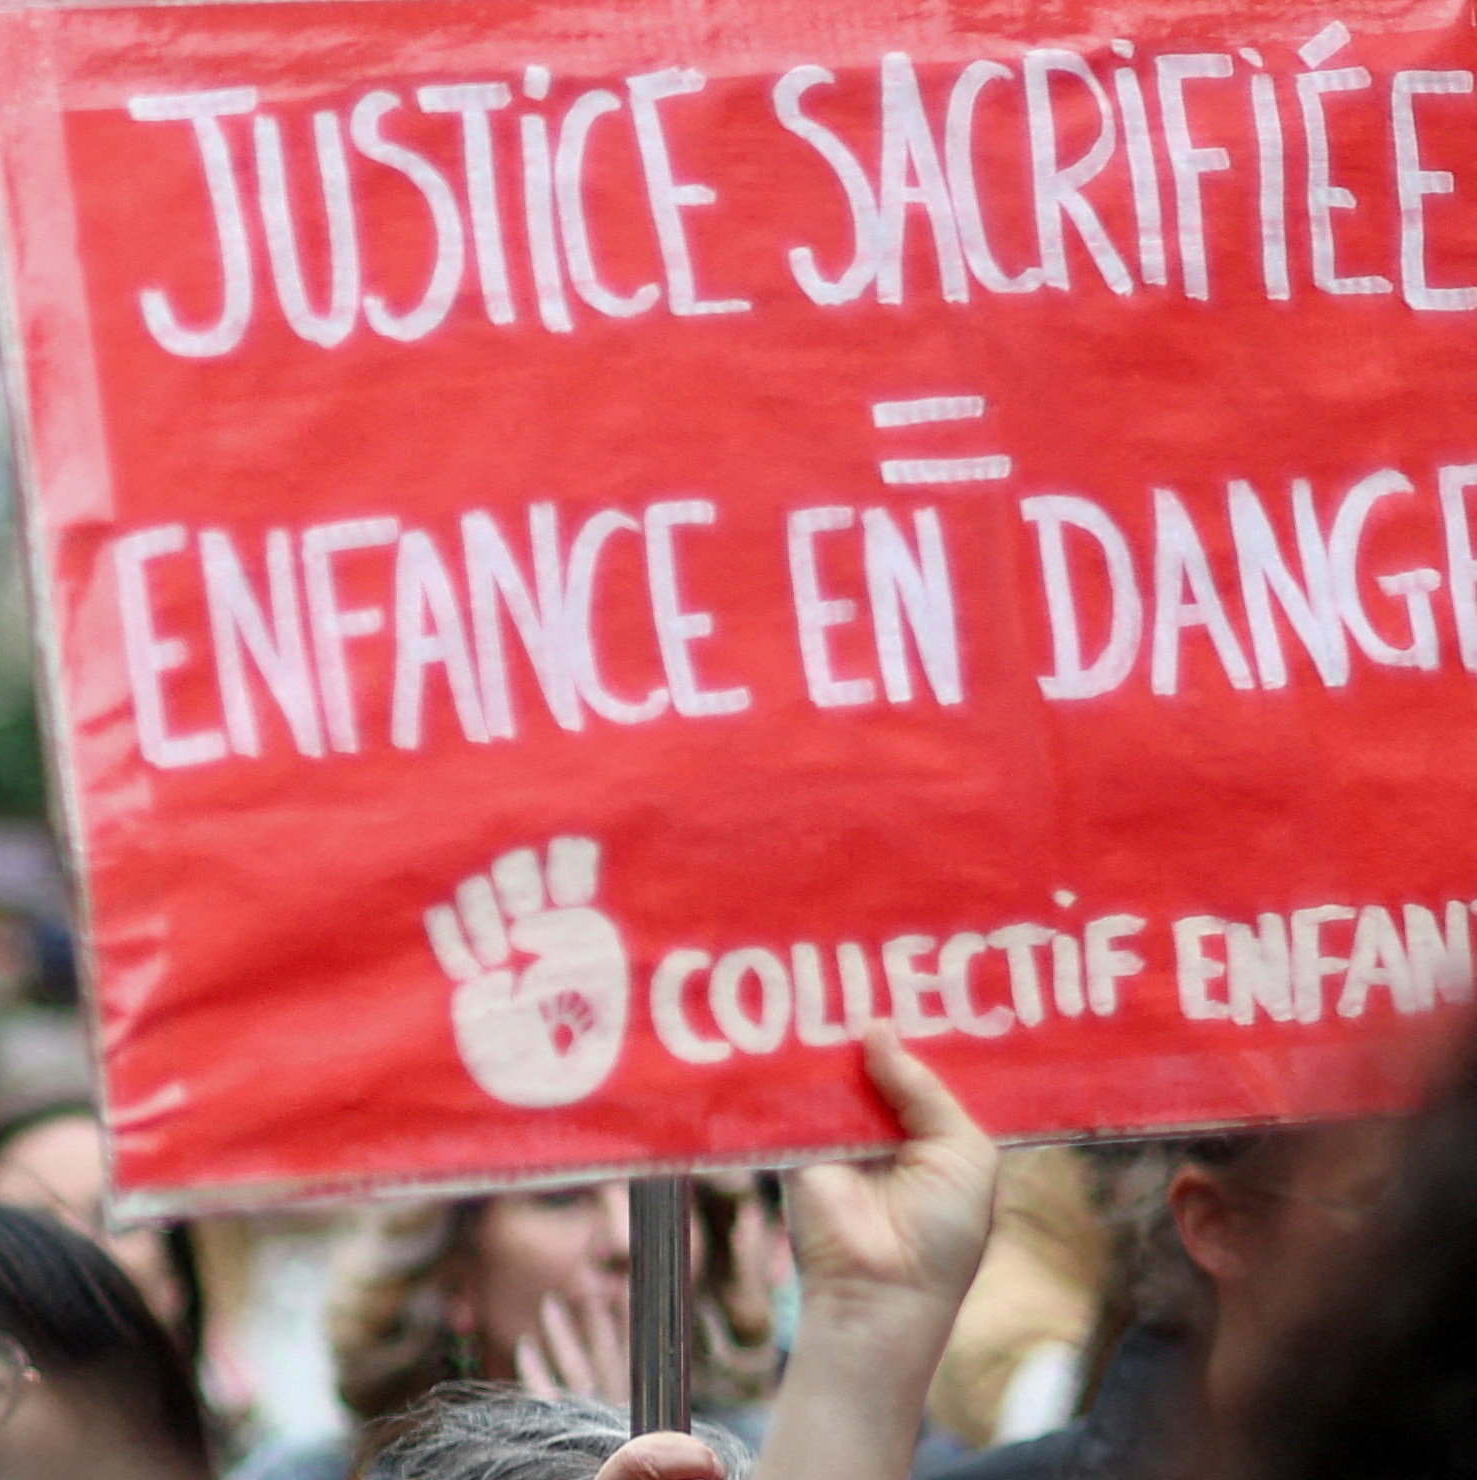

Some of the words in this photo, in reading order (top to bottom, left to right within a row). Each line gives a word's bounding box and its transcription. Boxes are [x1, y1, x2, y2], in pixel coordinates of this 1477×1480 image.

[110, 500, 750, 769] ENFANCE
[788, 506, 962, 707] EN
[1172, 900, 1477, 1026] ENFAN
